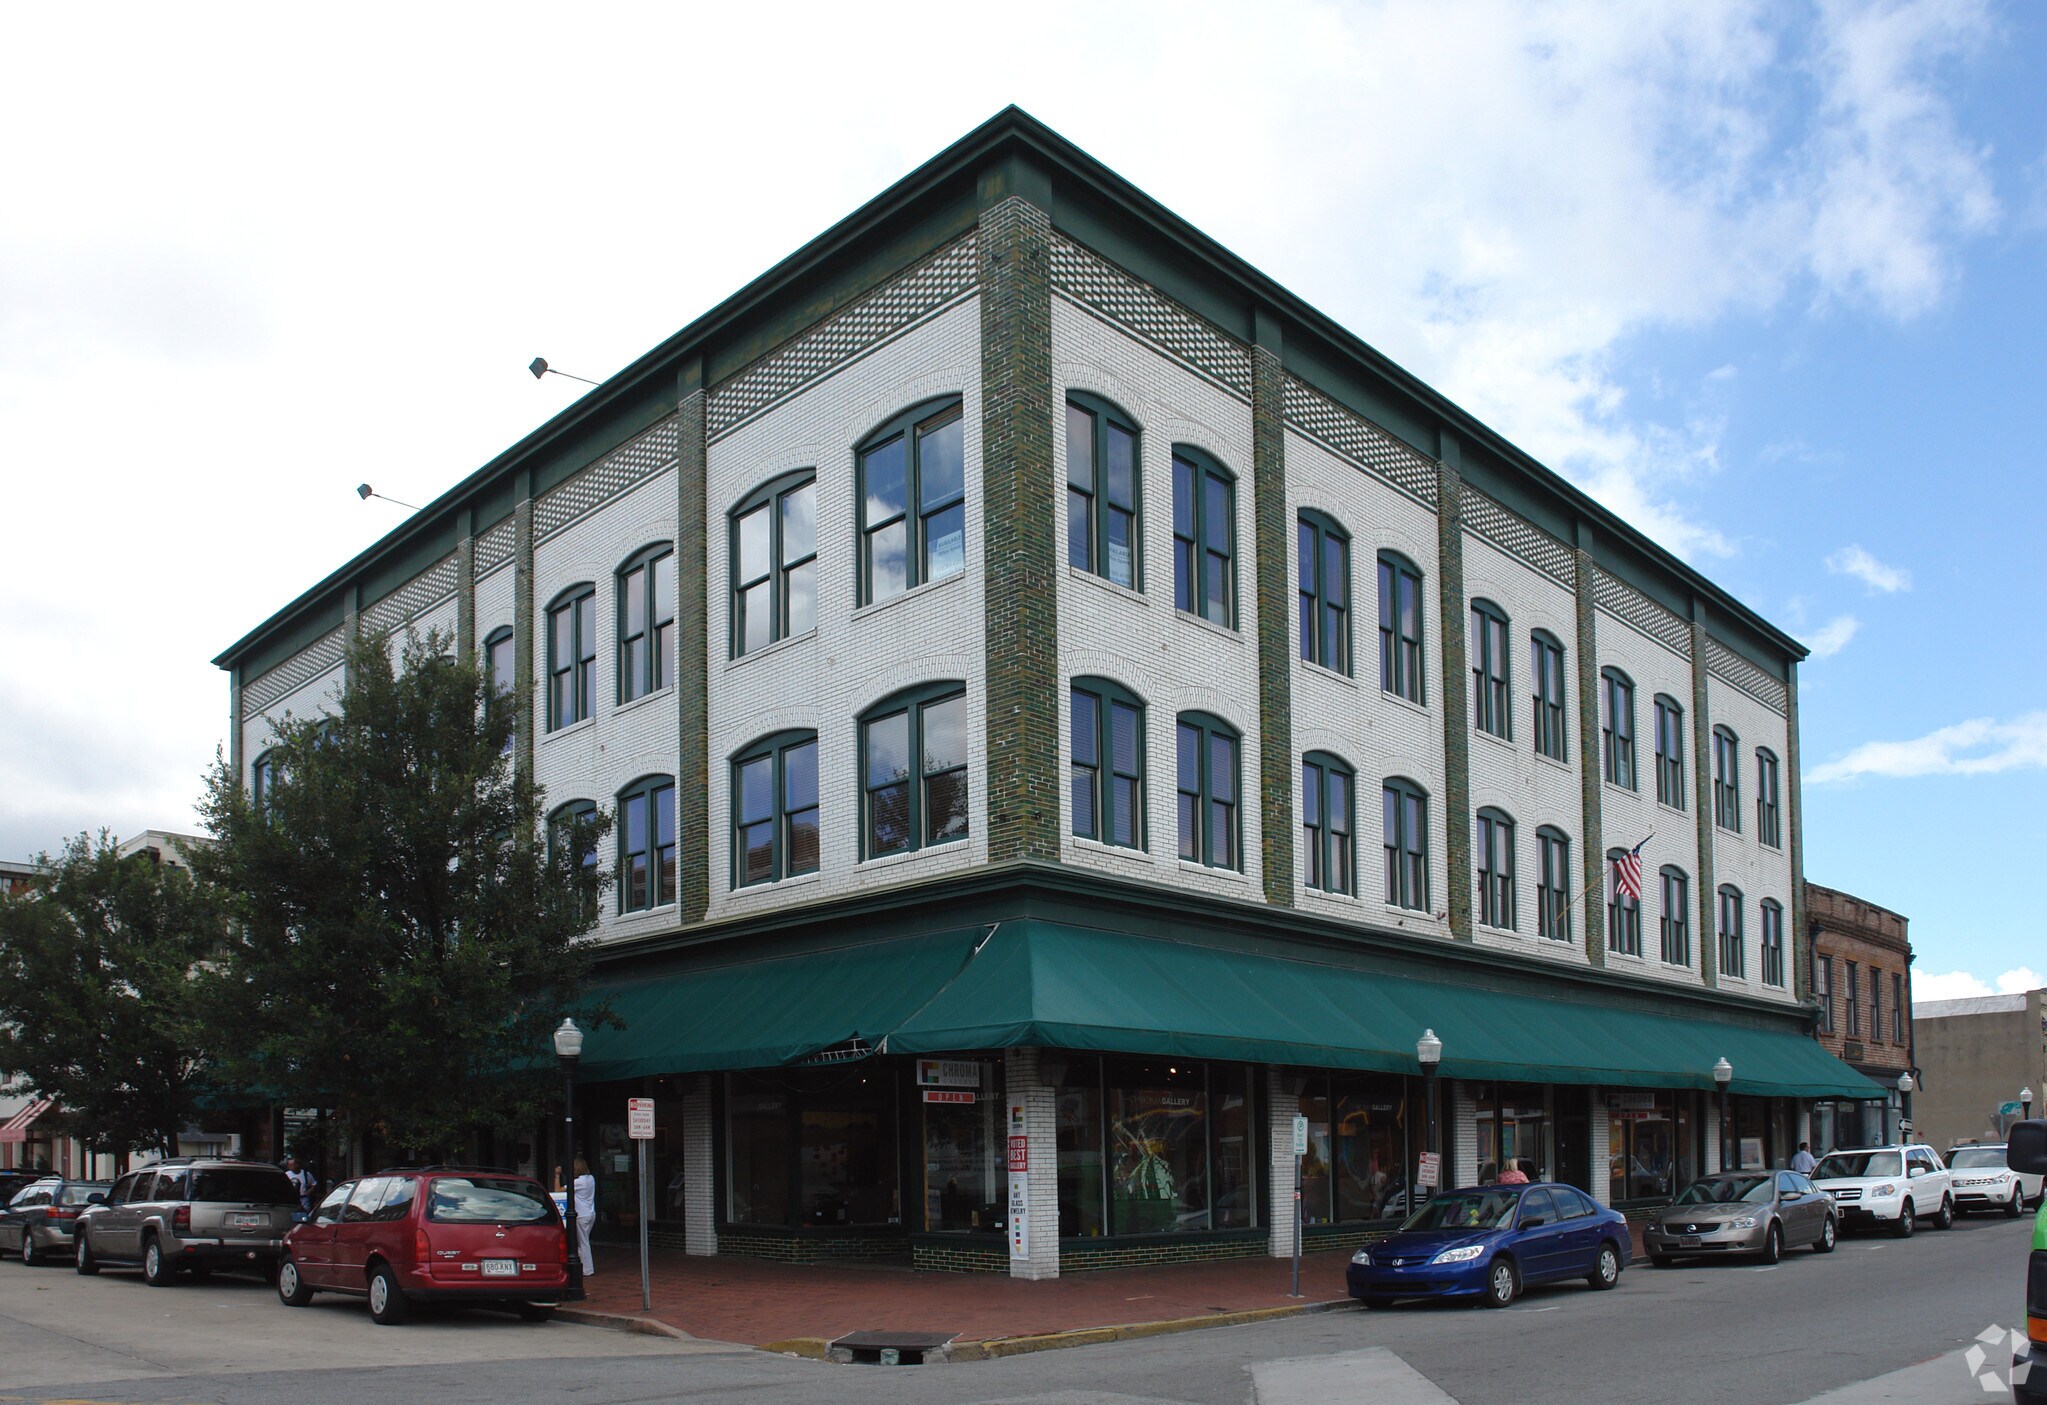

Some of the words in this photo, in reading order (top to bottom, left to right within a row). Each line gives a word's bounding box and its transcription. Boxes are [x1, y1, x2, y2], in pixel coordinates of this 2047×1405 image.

[943, 1063, 978, 1078] CHROMA
[938, 1092, 964, 1101] OPEN
[974, 1091, 999, 1100] ALLERY
[1161, 1097, 1190, 1105] GALLERY
[1011, 1139, 1025, 1148] VOTED
[1010, 1149, 1026, 1160] BEST
